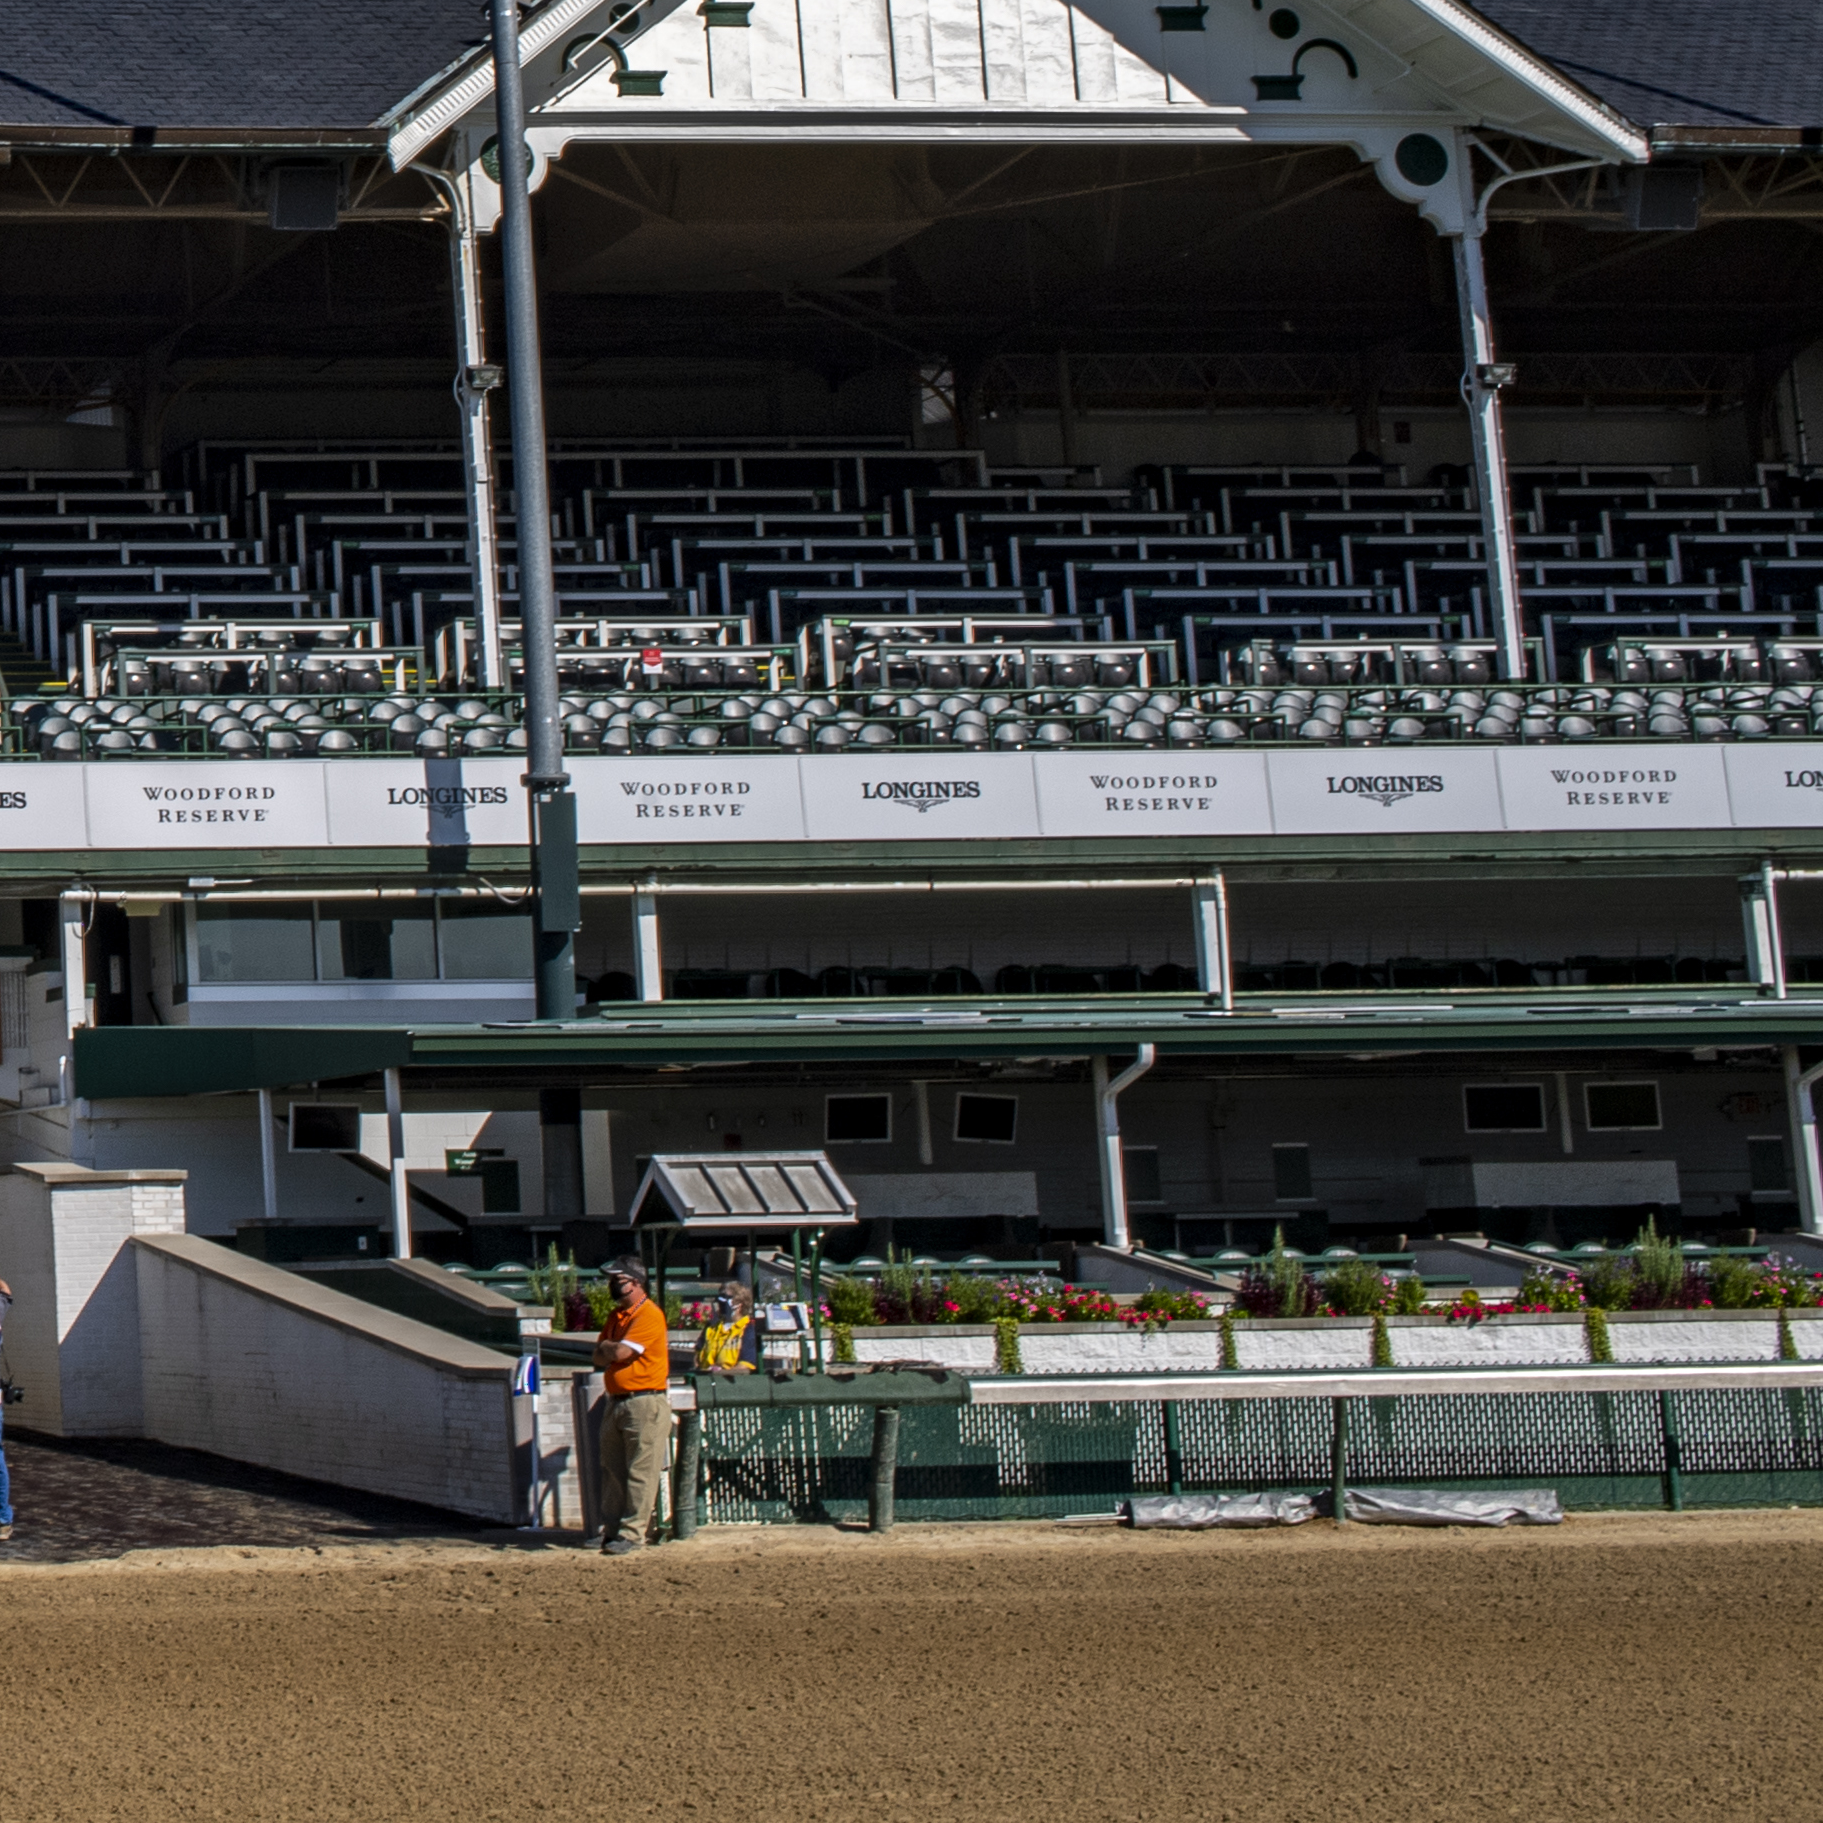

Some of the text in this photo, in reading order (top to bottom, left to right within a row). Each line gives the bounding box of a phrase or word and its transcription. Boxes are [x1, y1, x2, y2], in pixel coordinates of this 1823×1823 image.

[1089, 775, 1218, 789] WOODFORD
[1550, 769, 1677, 784] WOODFORD
[620, 781, 751, 796] WOODFORD
[861, 780, 981, 800] LONGINES
[1326, 775, 1444, 794] LONGINES
[142, 786, 275, 801] WOODFORD
[386, 786, 508, 806] LONGINES
[1567, 791, 1670, 806] RESERVE
[636, 803, 742, 818] RESERVE
[1105, 797, 1210, 811] RESERVE
[158, 808, 265, 823] RESERVE
